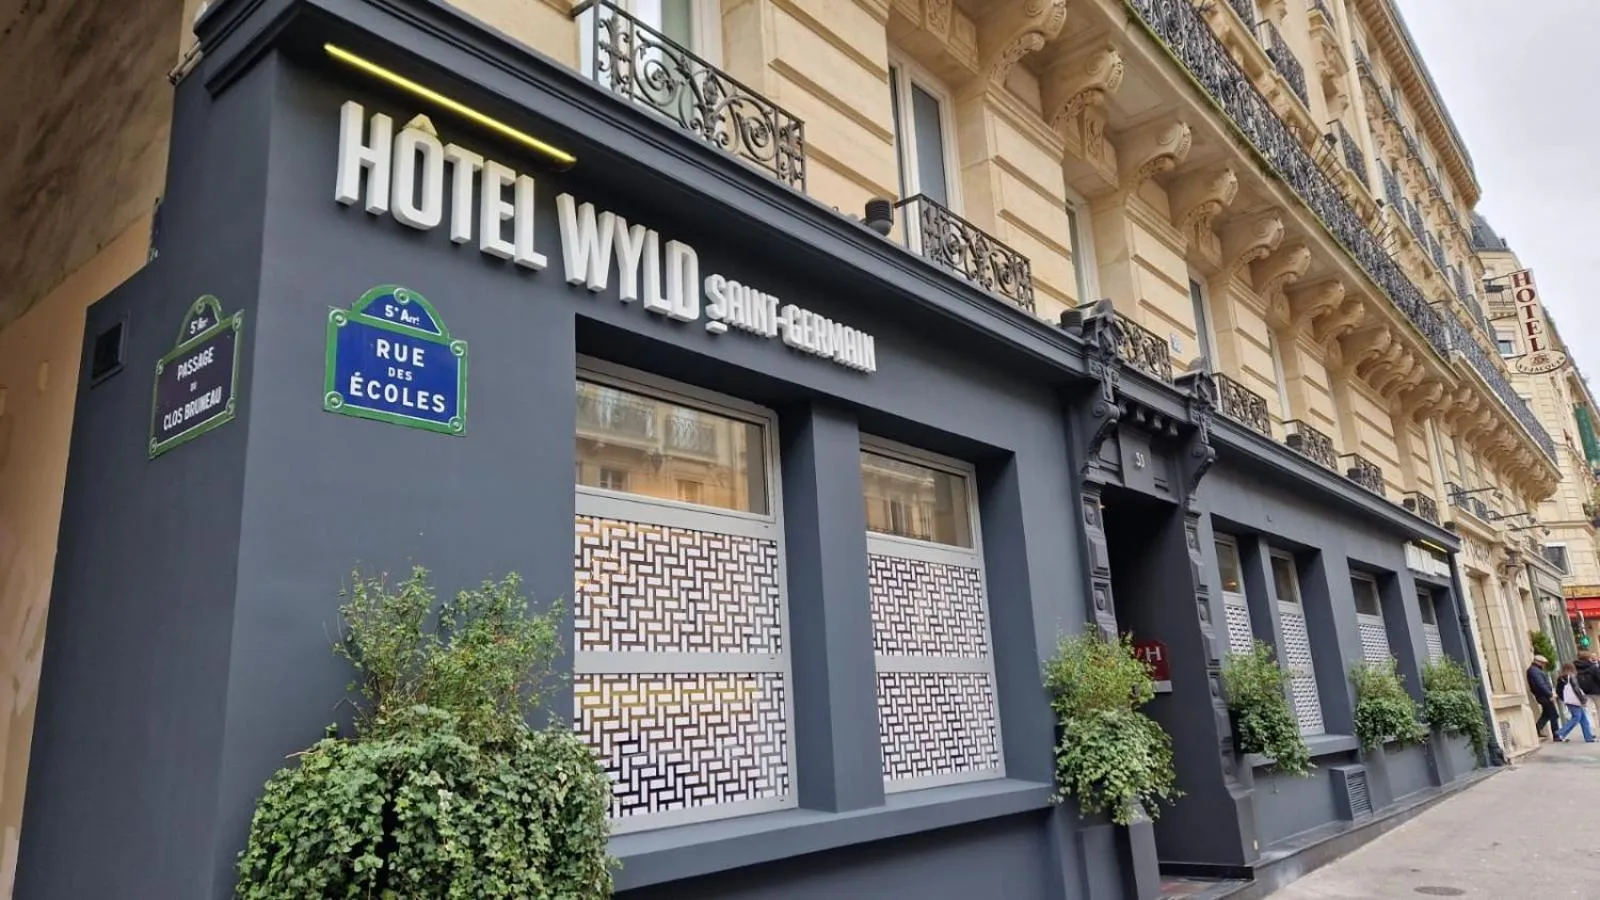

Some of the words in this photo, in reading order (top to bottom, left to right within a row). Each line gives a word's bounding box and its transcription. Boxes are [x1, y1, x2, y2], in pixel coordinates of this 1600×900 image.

[335, 100, 547, 271] HÔTEL
[556, 192, 701, 323] WYLD
[704, 273, 877, 373] SAINT-GERMAIN
[1512, 271, 1546, 352] HOTEL
[177, 346, 215, 381] PASSAGE
[376, 338, 425, 368] RUE
[387, 366, 413, 382] DES
[163, 406, 184, 431] CLOS
[184, 385, 223, 421] BRUNEAU
[350, 371, 446, 413] ÉCOLES
